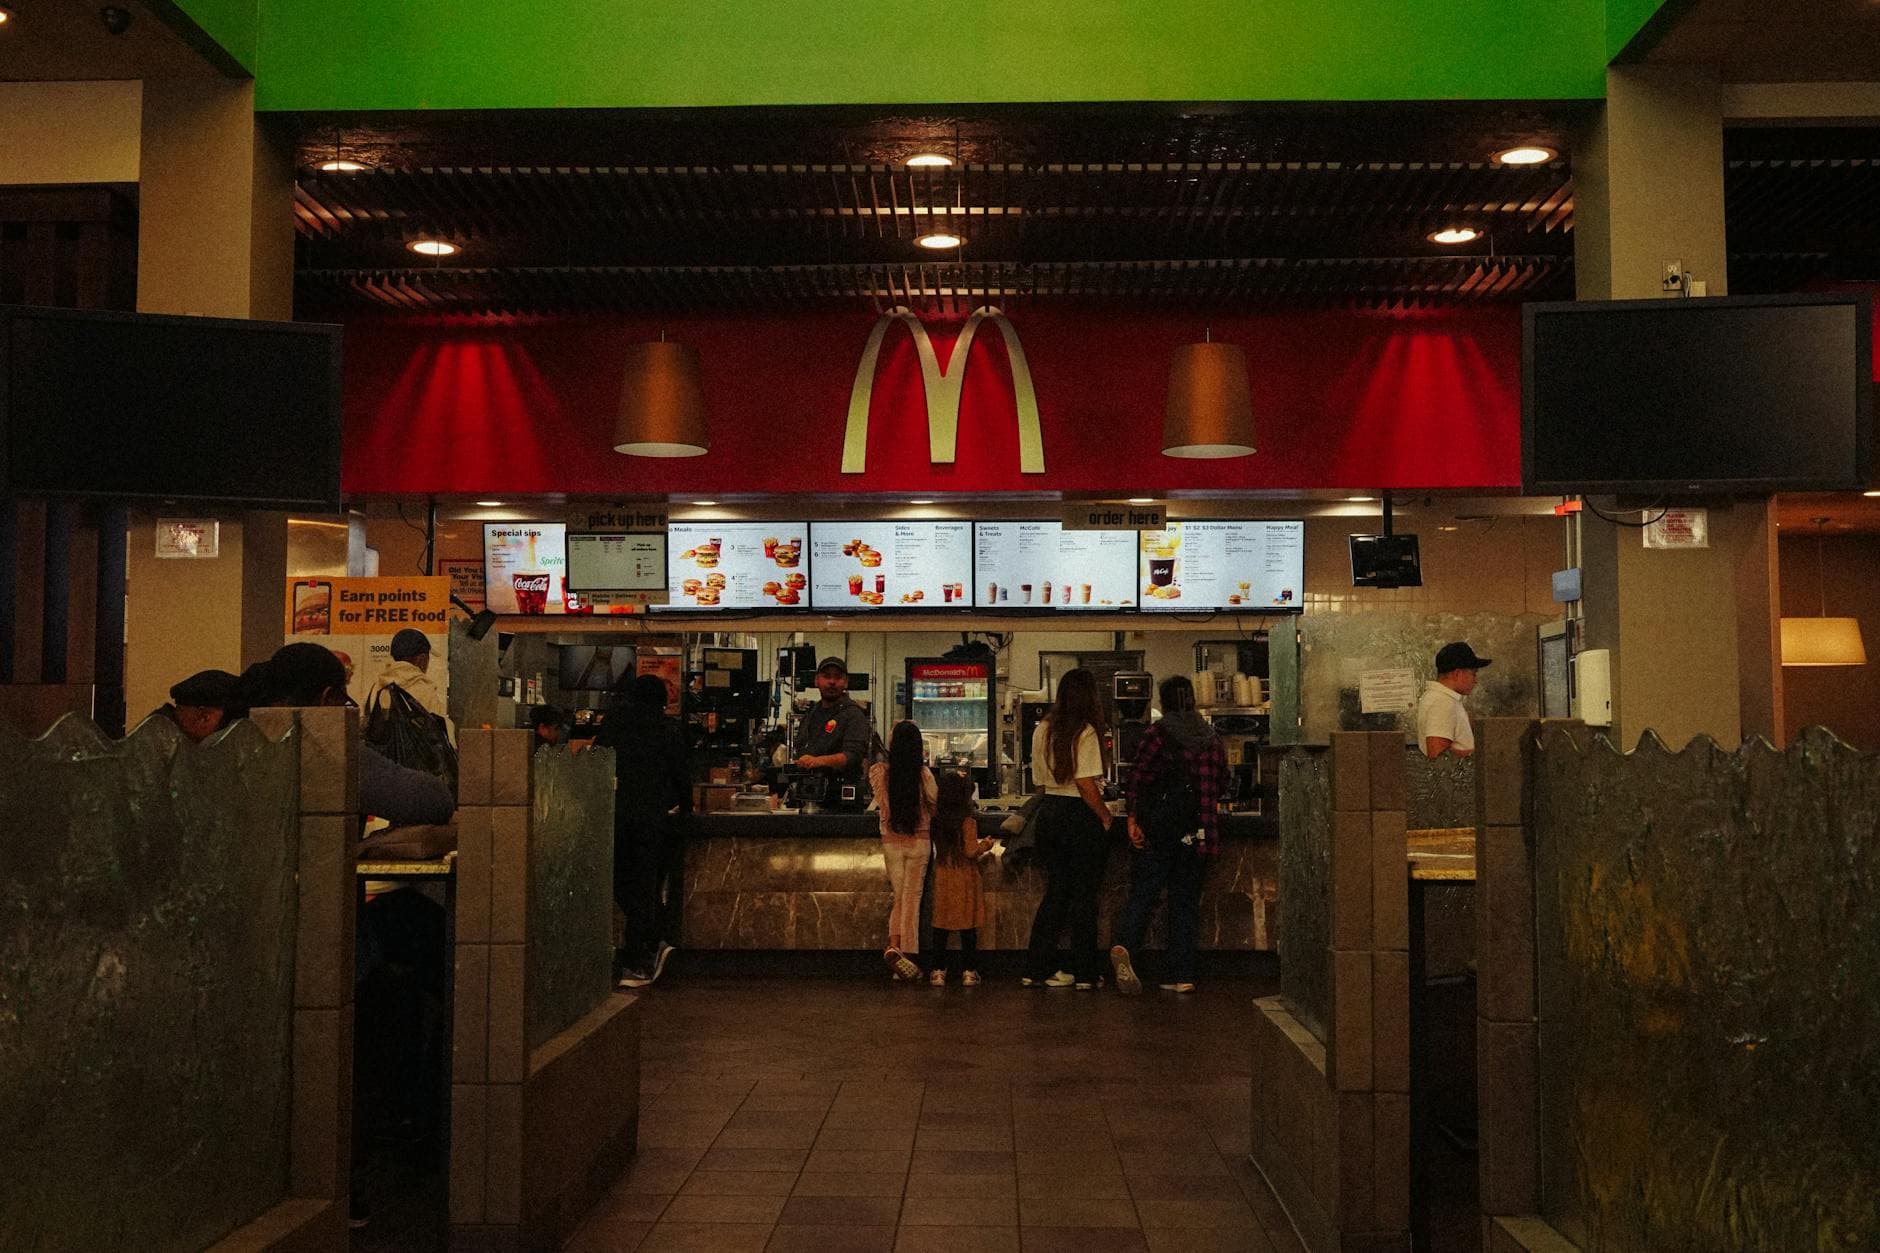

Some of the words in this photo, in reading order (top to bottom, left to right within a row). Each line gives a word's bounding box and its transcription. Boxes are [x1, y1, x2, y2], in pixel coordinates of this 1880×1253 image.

[588, 512, 617, 529] pick
[618, 514, 633, 529] up
[636, 512, 665, 526] here
[1089, 511, 1124, 524] order
[1129, 511, 1159, 524] here
[491, 530, 522, 538] Special
[524, 530, 542, 538] sips
[540, 556, 565, 567] Sprite
[340, 590, 375, 602] Earn
[378, 588, 427, 605] points
[339, 609, 362, 622] for
[364, 609, 409, 622] FREE
[411, 609, 446, 622] food
